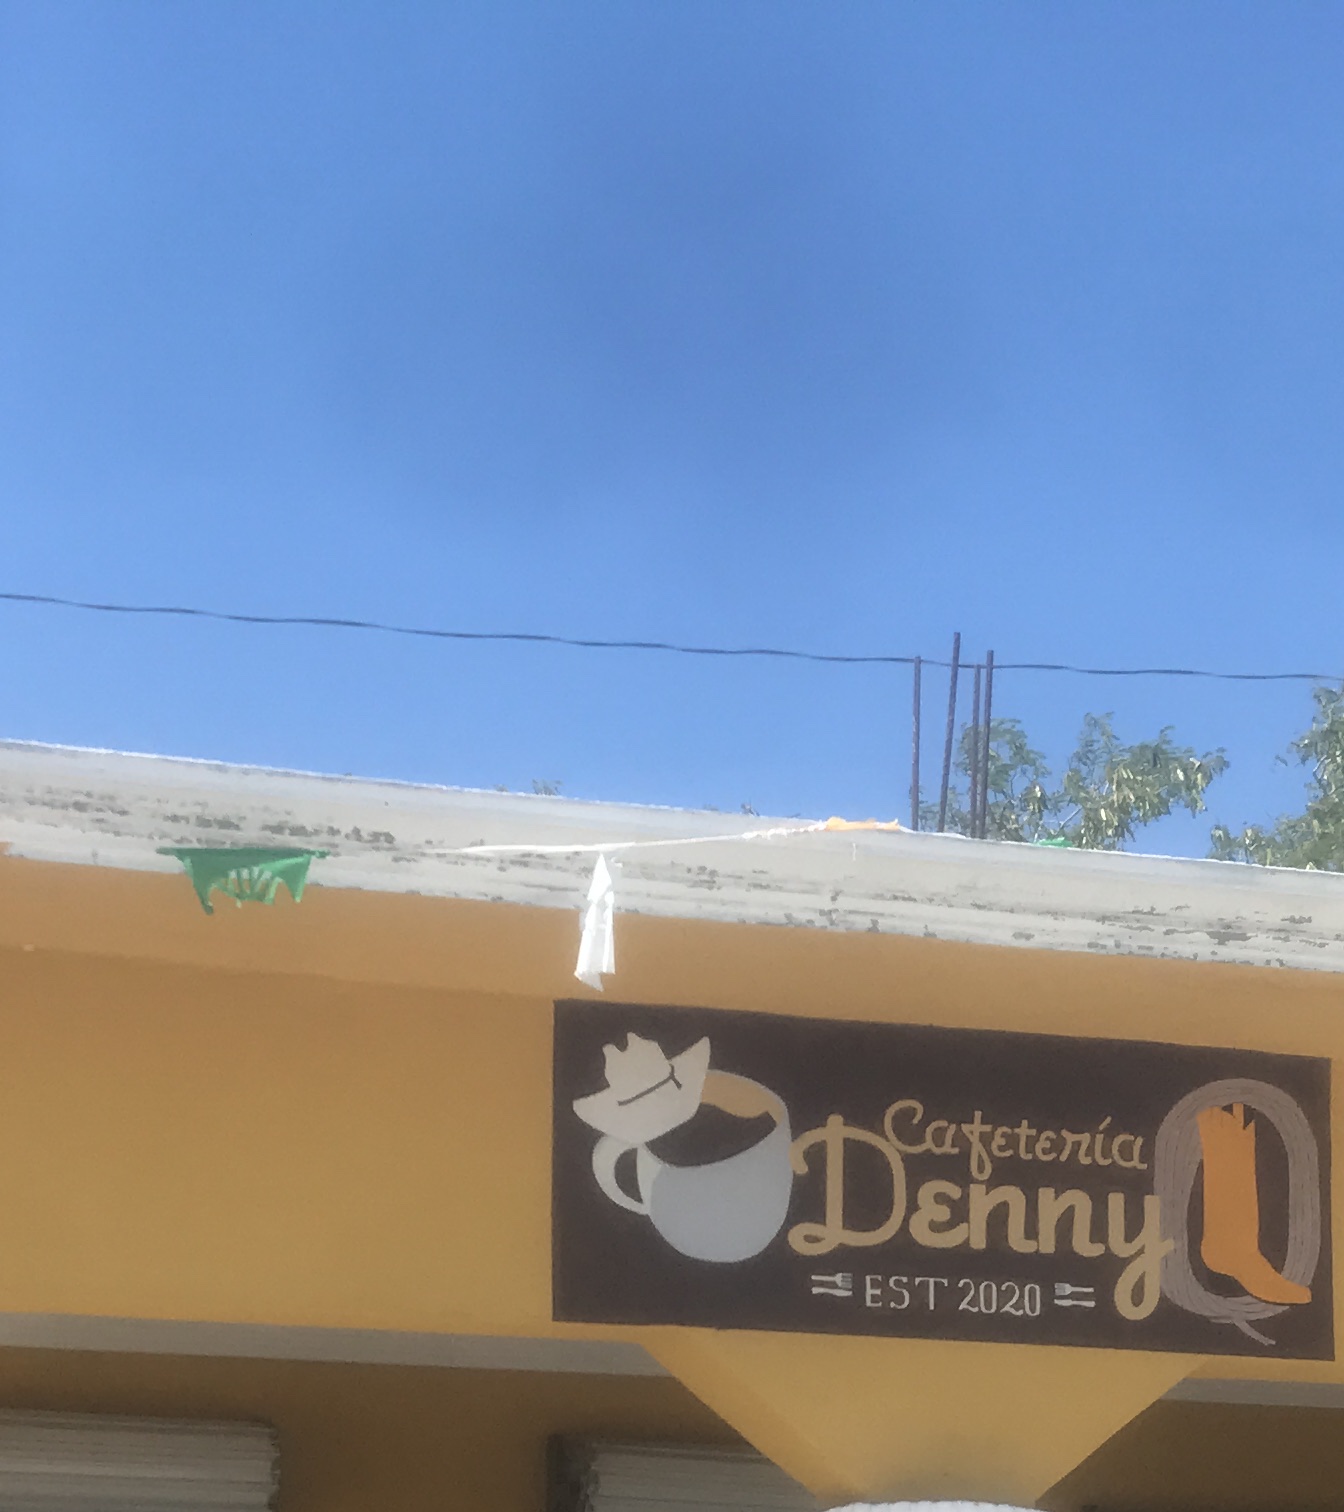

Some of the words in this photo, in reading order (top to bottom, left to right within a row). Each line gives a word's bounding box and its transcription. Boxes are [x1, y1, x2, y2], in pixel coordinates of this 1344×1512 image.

[884, 1099, 1148, 1180] Cafetería
[788, 1113, 1175, 1320] Denny
[864, 1274, 949, 1312] EST
[957, 1279, 1042, 1318] 2020
